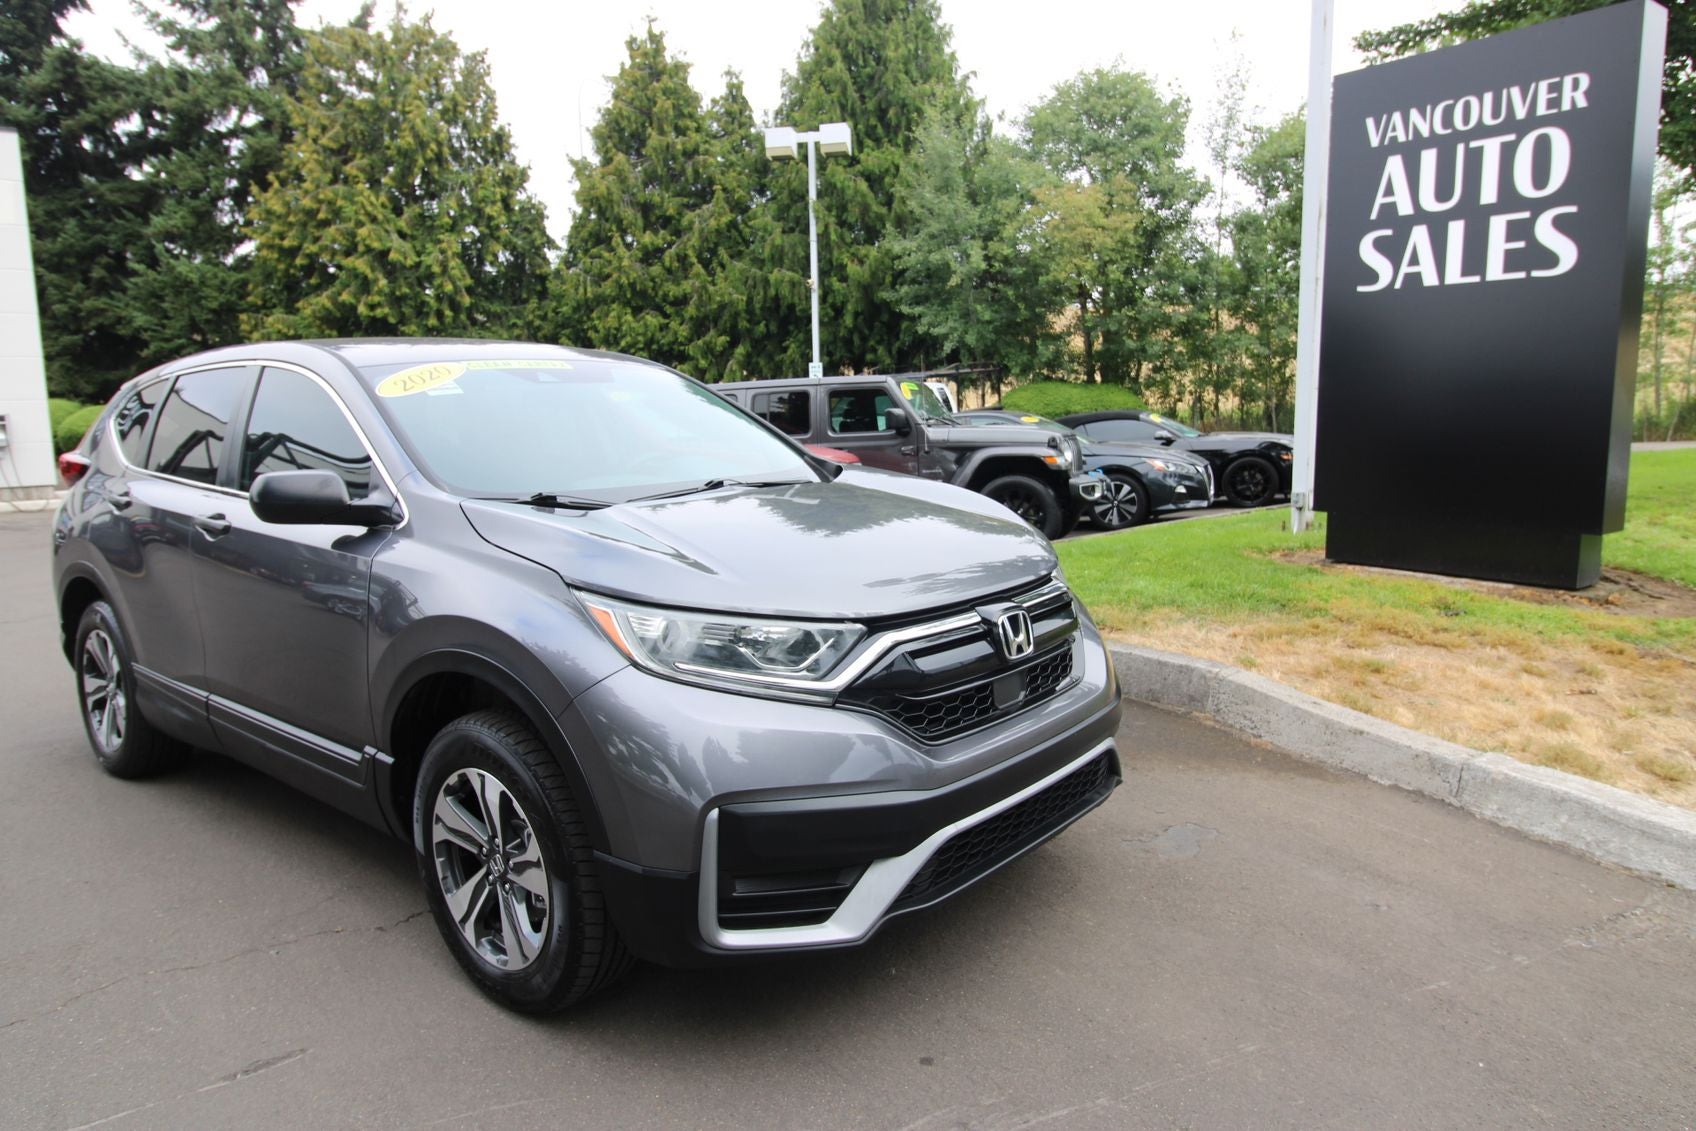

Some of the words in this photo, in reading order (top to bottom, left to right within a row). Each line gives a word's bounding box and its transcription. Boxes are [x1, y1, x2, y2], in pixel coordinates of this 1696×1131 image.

[1365, 72, 1591, 148] VANCOUVER
[1370, 126, 1572, 220] AUTO
[1356, 205, 1579, 292] SALES
[393, 365, 452, 392] 2020
